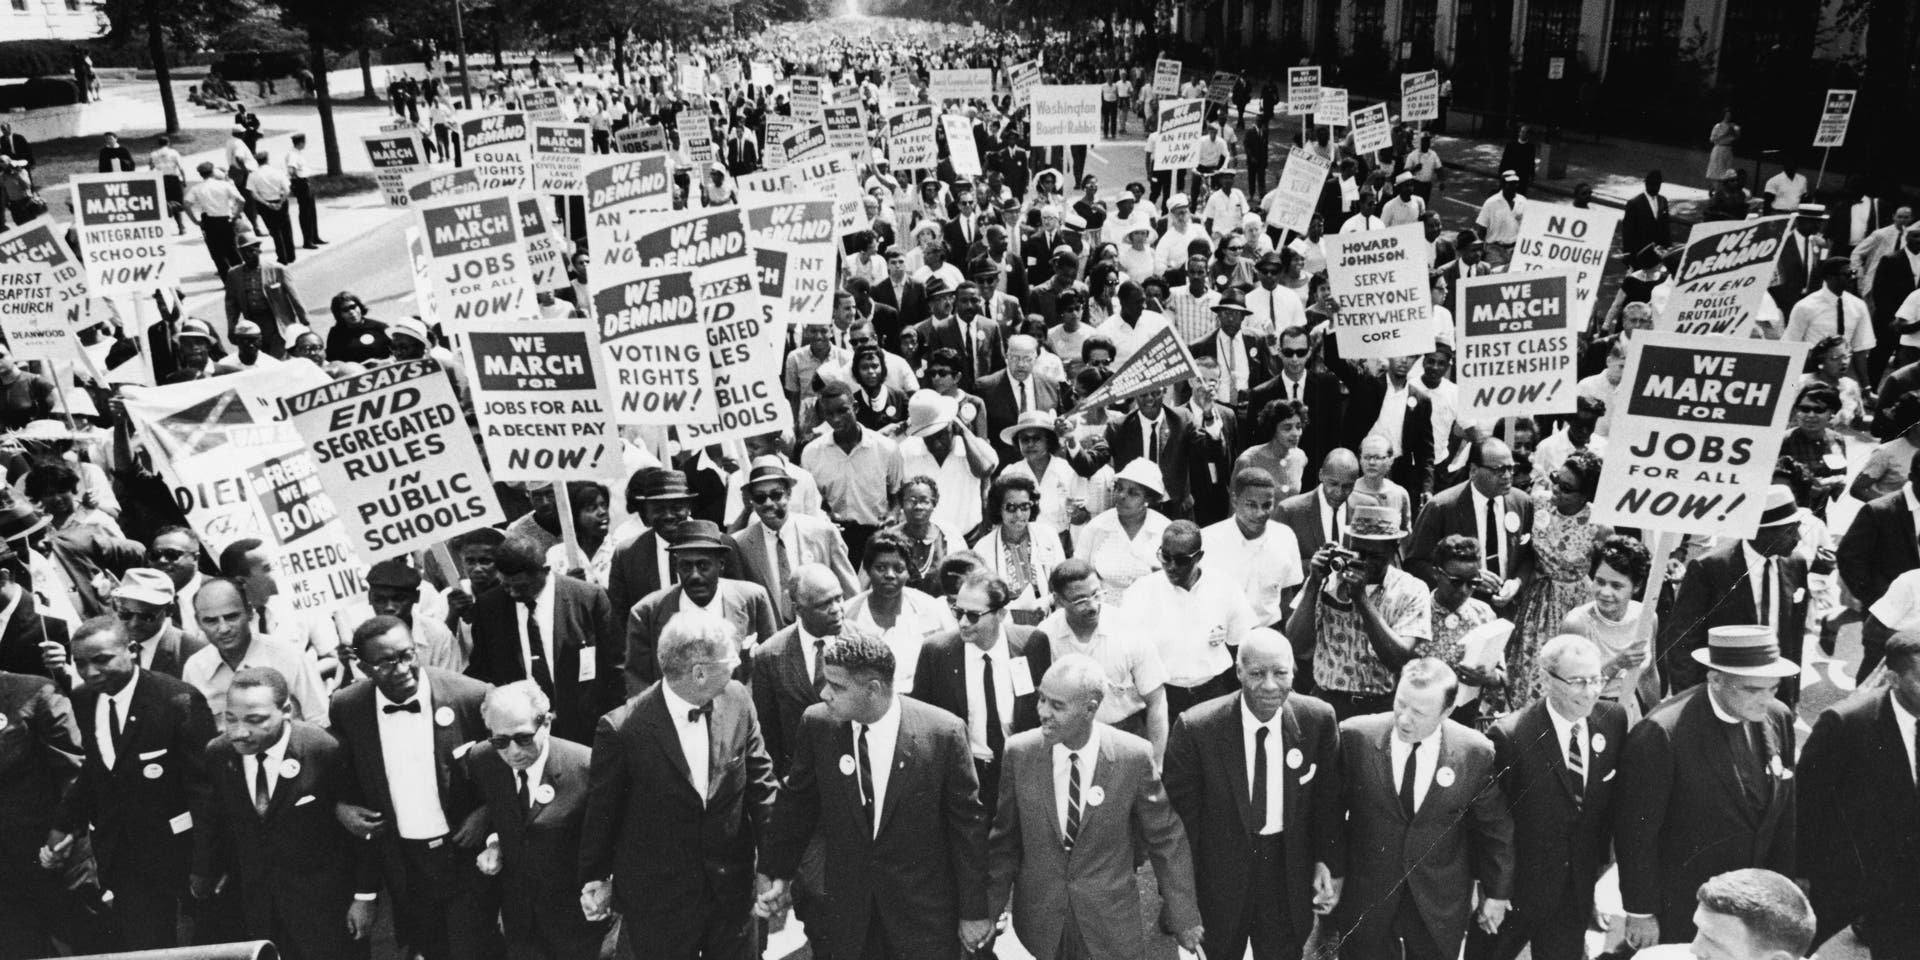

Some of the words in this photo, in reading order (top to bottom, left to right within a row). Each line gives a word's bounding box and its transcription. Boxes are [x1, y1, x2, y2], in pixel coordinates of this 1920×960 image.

[1292, 75, 1317, 83] MARCH
[835, 108, 845, 117] WE
[903, 109, 918, 122] WE
[1036, 101, 1096, 116] Washington
[1174, 104, 1190, 119] WE
[1293, 102, 1318, 111] NOW!
[1407, 108, 1435, 117] NOW!
[481, 115, 504, 131] WE
[828, 115, 858, 125] MARCH
[893, 116, 931, 136] DEMAND
[1036, 121, 1064, 135] Board
[1067, 121, 1096, 135] Rabbis
[1356, 113, 1383, 125] MARCH
[467, 125, 524, 149] DEMAND
[540, 136, 582, 147] MARCH
[553, 128, 569, 137] WE
[894, 137, 907, 145] AN
[910, 134, 932, 143] FEPC
[1161, 134, 1174, 142] AN
[1178, 131, 1199, 140] FEPC
[380, 141, 397, 149] WE
[622, 141, 649, 153] JOBS
[903, 145, 926, 154] LAW
[1169, 143, 1190, 152] LAW
[1361, 136, 1388, 149] NOW!
[372, 148, 413, 160] MARCH
[475, 153, 522, 163] EQUAL
[898, 152, 931, 165] NOW!
[1162, 152, 1196, 164] NOW!
[612, 161, 642, 183] WE
[802, 160, 846, 181] I.U.E.
[105, 184, 129, 196] WE
[430, 174, 456, 194] WE
[542, 179, 583, 190] NOW!
[593, 173, 666, 207] DEMAND
[87, 196, 153, 215] MARCH
[454, 204, 483, 221] WE
[771, 204, 806, 225] WE
[109, 214, 135, 222] FOR
[596, 211, 621, 227] AN
[1547, 215, 1588, 238] NO
[86, 226, 163, 244] INTEGRATED
[436, 216, 509, 244] MARCH
[670, 218, 708, 248] WE
[751, 219, 831, 241] DEMAND
[0, 238, 27, 255] WE
[461, 237, 490, 250] FOR
[1342, 238, 1398, 254] HOWARD
[1716, 226, 1758, 253] WE
[90, 245, 166, 262] SCHOOLS
[650, 231, 742, 268] DEMAND
[1520, 238, 1543, 256] U.S.
[1548, 243, 1603, 266] DOUGH
[445, 253, 515, 283] JOBS
[1683, 238, 1777, 280] DEMAND
[1, 273, 42, 285] FIRST
[101, 262, 165, 285] NOW!
[1355, 271, 1396, 287] SERVE
[0, 287, 51, 300] BAPTIST
[451, 284, 481, 296] FOR
[491, 276, 517, 288] ALL
[624, 279, 660, 307] WE
[701, 275, 749, 300] AYS:
[1501, 284, 1532, 300] WE
[1685, 281, 1716, 294] AN
[1719, 276, 1756, 292] END
[455, 287, 523, 319] NOW!
[1339, 288, 1420, 308] EVERYONE
[1694, 295, 1736, 309] POLICE
[2, 301, 54, 314] CHURCH
[604, 296, 693, 337] DEMAND
[1337, 305, 1427, 326] EVERYWHERE
[1473, 298, 1560, 322] MARCH
[1678, 305, 1741, 322] BRUTALITY
[1499, 320, 1533, 332] FOR
[1675, 312, 1749, 335] NOW!
[509, 337, 546, 353] WE
[1362, 329, 1401, 343] CORE
[609, 344, 700, 362] VOTING
[1466, 342, 1511, 359] FIRST
[1518, 337, 1568, 355] CLASS
[484, 355, 584, 376] MARCH
[1143, 358, 1168, 380] JOBS
[1462, 356, 1570, 378] CITIZENSHIP
[1693, 355, 1737, 376] WE
[295, 381, 350, 412] UAW
[357, 358, 433, 393] SAYS:
[517, 378, 557, 389] FOR
[620, 368, 699, 386] RIGHTS
[621, 387, 702, 412] NOW!
[1473, 379, 1562, 407] NOW!
[1642, 375, 1772, 406] MARCH
[329, 387, 421, 432] END
[484, 401, 527, 415] JOBS
[532, 400, 565, 414] FOR
[571, 399, 603, 413] ALL
[1677, 405, 1726, 419] FOR
[313, 403, 456, 464] SEGREGATED
[488, 425, 501, 437] A
[504, 423, 567, 437] DECENT
[573, 422, 606, 436] PAY
[343, 433, 446, 481] RULES
[508, 444, 605, 470] NOW!
[1630, 431, 1754, 466] JOBS
[1629, 465, 1679, 480] FOR
[1694, 471, 1740, 485] ALL
[277, 484, 301, 504] WE
[357, 473, 472, 525] PUBLIC
[1615, 487, 1746, 522] NOW!
[364, 496, 487, 551] SCHOOLS
[280, 543, 347, 576] FREEDO
[292, 579, 310, 594] WE
[292, 591, 327, 610] MUST
[328, 568, 369, 600] LIVE
